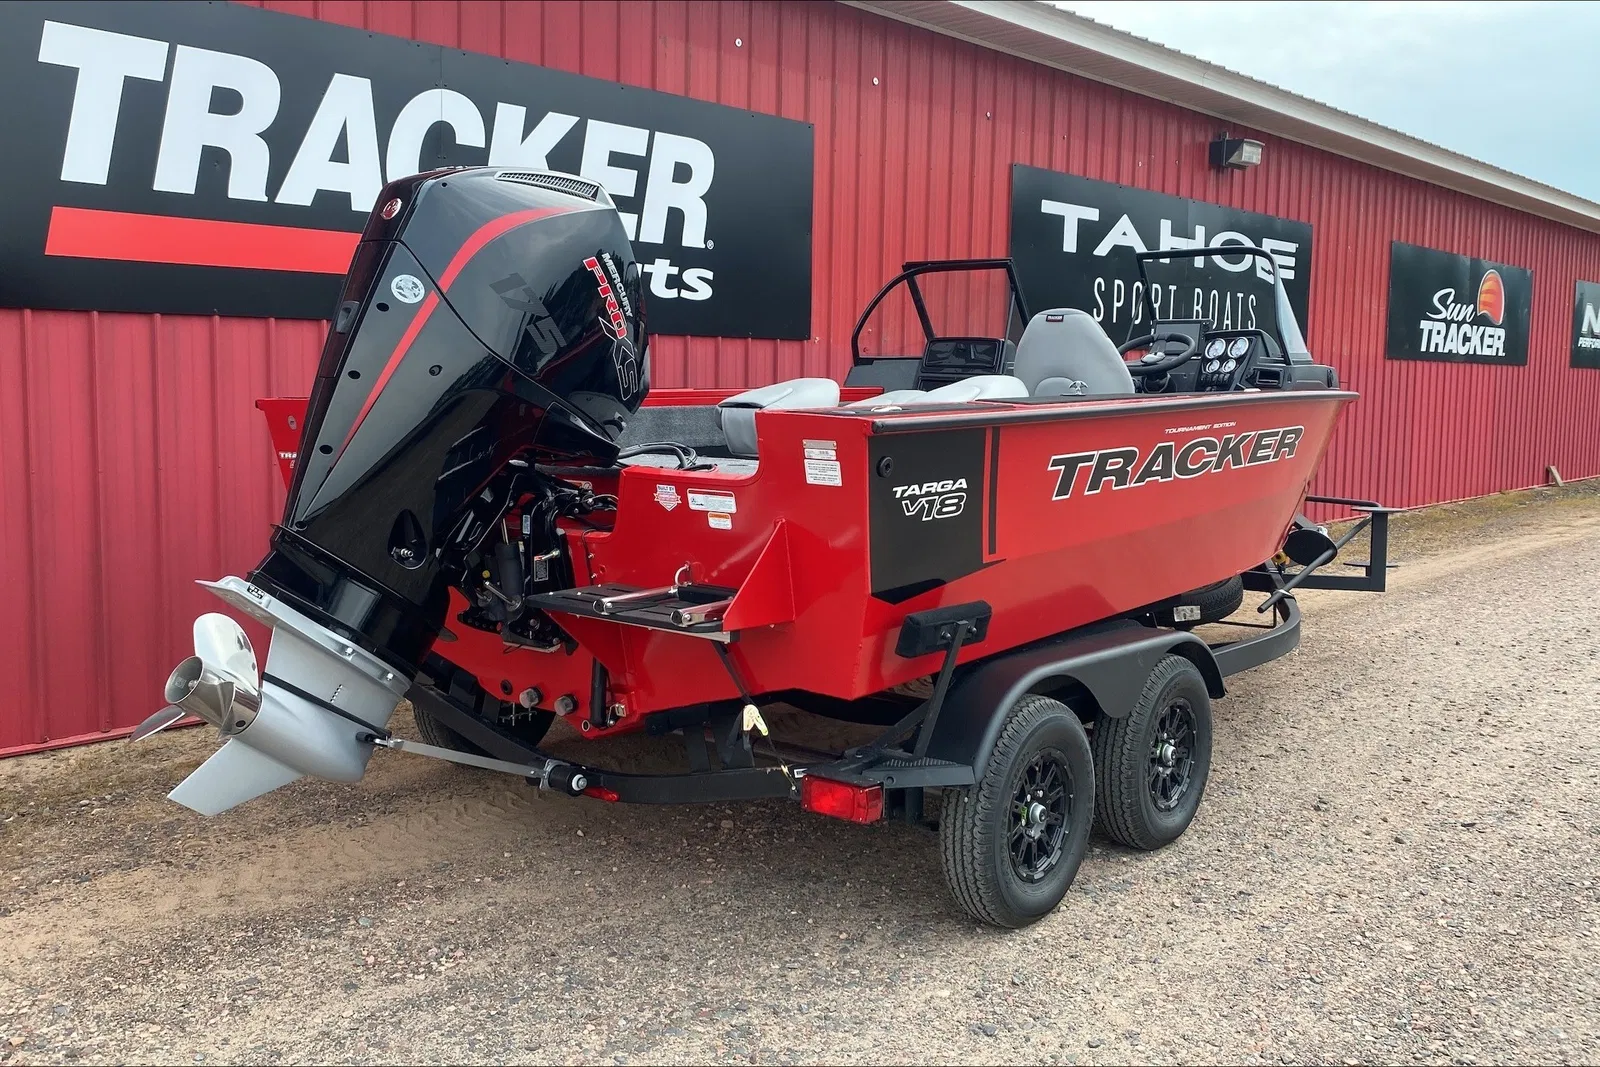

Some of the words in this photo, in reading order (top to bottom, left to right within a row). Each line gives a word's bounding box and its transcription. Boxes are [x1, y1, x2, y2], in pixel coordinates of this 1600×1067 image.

[38, 20, 715, 249] TRACKER
[1041, 199, 1297, 283] TAHOE
[602, 252, 633, 317] MERCURY
[1093, 277, 1177, 326] SPORT
[1193, 288, 1256, 331] BOATS
[1426, 288, 1476, 322] Sun
[1420, 320, 1506, 356] TRACKER
[1165, 424, 1212, 434] TOURNAMENT
[1213, 421, 1237, 429] EDITION
[1047, 425, 1304, 501] TRACKER
[893, 478, 968, 498] TARGA
[901, 492, 967, 521] V18
